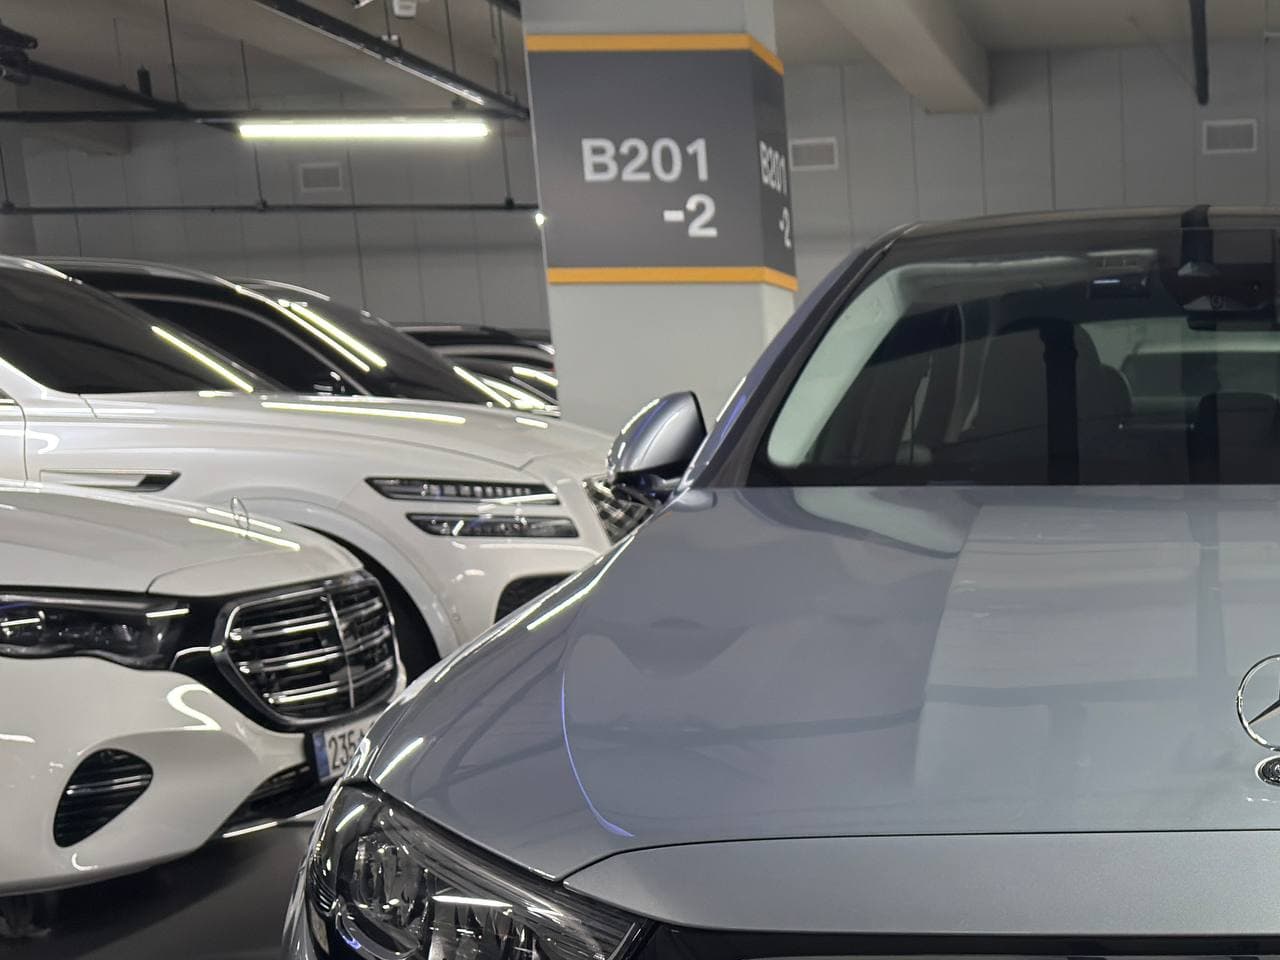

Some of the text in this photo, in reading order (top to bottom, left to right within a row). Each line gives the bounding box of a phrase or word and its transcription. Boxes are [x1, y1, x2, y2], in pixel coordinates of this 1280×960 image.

[581, 138, 708, 182] B201
[760, 140, 787, 195] B201
[663, 194, 718, 237] -2
[779, 206, 792, 248] -2
